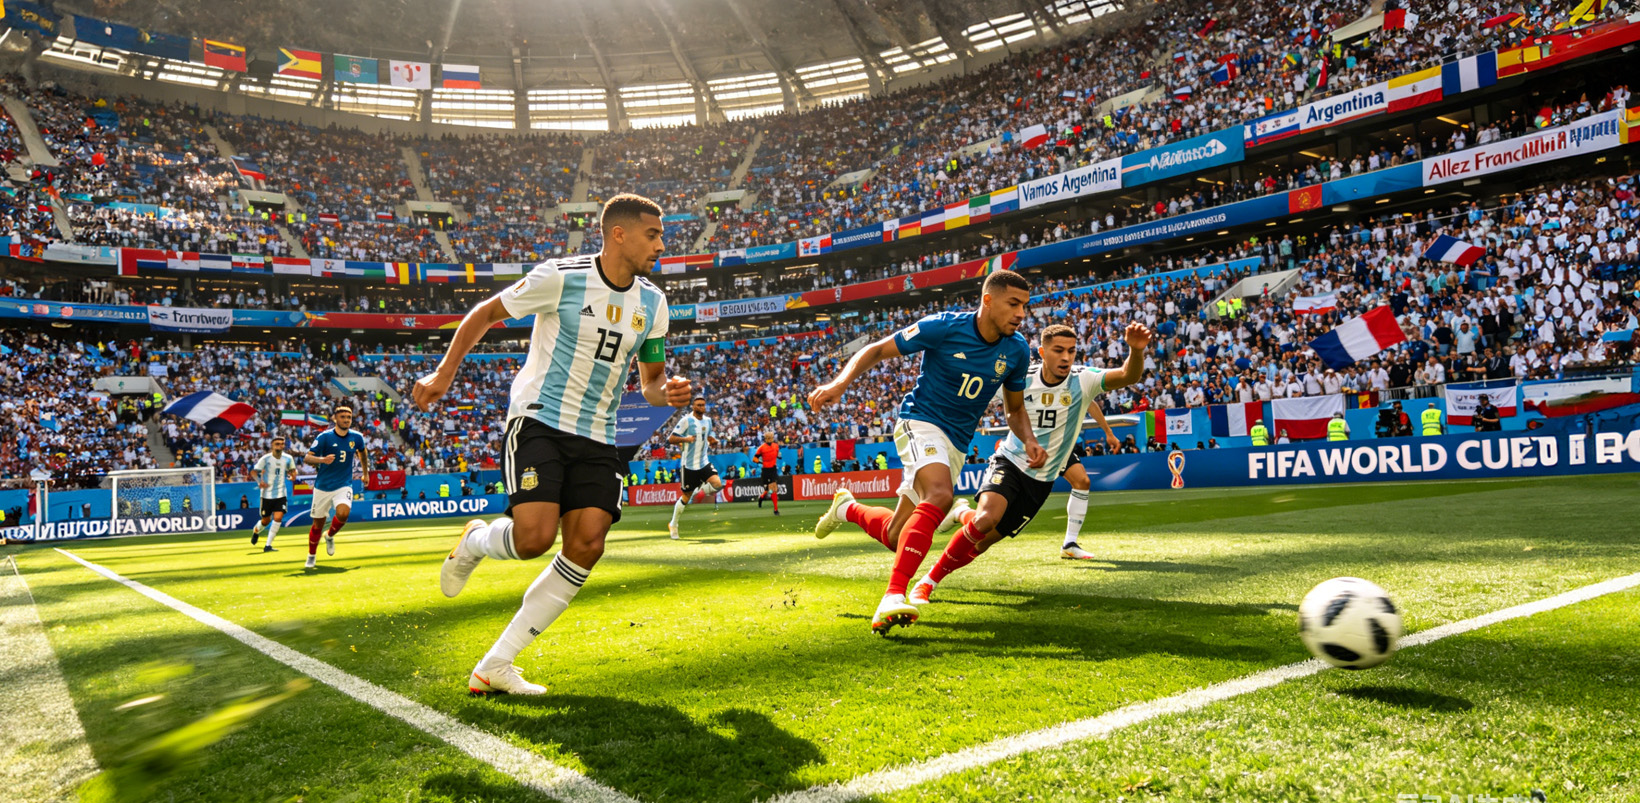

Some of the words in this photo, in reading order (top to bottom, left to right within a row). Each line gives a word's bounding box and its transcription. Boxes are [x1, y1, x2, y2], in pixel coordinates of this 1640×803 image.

[1306, 91, 1385, 124] Argentina
[1429, 158, 1470, 181] Allez
[1022, 180, 1058, 202] Vamos
[594, 327, 623, 363] 13
[957, 373, 984, 400] 10
[1036, 409, 1057, 429] 19
[339, 450, 346, 463] 3
[1248, 449, 1316, 479] FIFA
[1318, 443, 1448, 475] WORLD
[372, 503, 405, 519] FIFA
[405, 500, 458, 516] WORLD
[459, 498, 489, 513] CUP
[140, 516, 204, 533] WORLD
[206, 514, 244, 530] CUP
